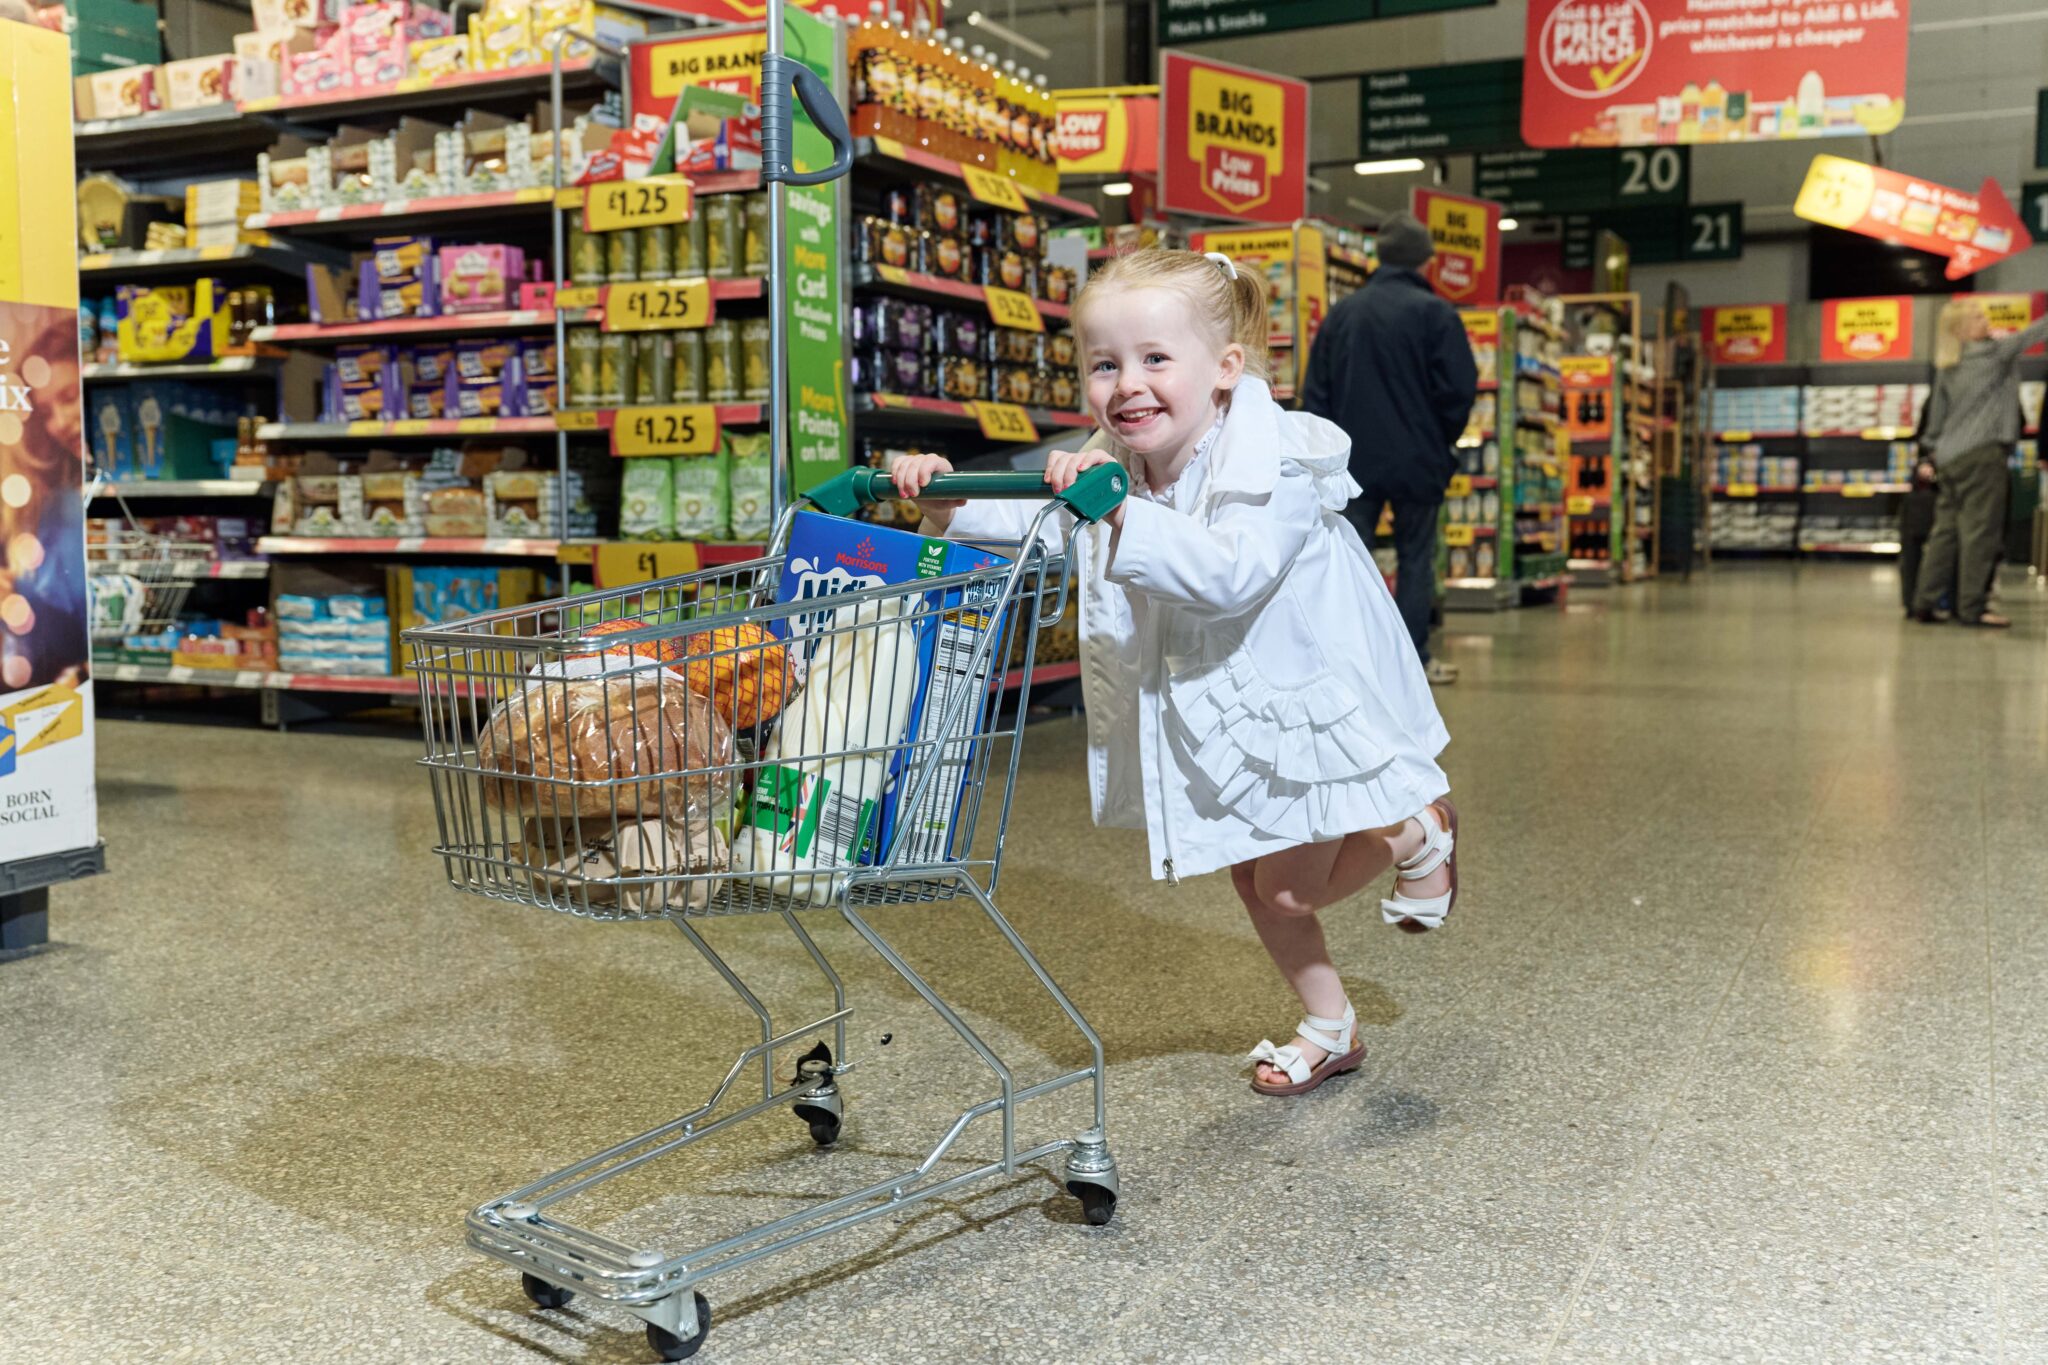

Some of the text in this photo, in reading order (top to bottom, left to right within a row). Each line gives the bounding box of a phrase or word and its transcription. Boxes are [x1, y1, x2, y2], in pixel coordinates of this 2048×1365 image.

[1554, 19, 1635, 47] PRICE
[1659, 17, 1701, 39] price
[1705, 9, 1779, 32] matched
[1780, 10, 1800, 26] to
[1553, 38, 1636, 66] MATCH
[1689, 31, 1774, 53] whichever
[1794, 26, 1865, 49] cheaper
[668, 49, 765, 76] BIG BRAN
[1219, 88, 1253, 116] BIG
[1195, 110, 1277, 148] BRANDS
[1620, 147, 1682, 195] 20
[608, 187, 668, 216] £1.25
[788, 189, 832, 228] savings
[1446, 210, 1467, 229] BIG
[1691, 213, 1731, 251] 21
[797, 272, 828, 299] Card
[628, 290, 689, 319] £1.25
[801, 384, 835, 414] More
[635, 416, 696, 444] £1.25
[799, 409, 840, 438] Points
[801, 440, 840, 462] on fuel
[637, 553, 658, 579] £1
[836, 551, 888, 574] Morrisons
[6, 788, 53, 808] BORN
[0, 805, 59, 826] SOCIAL
